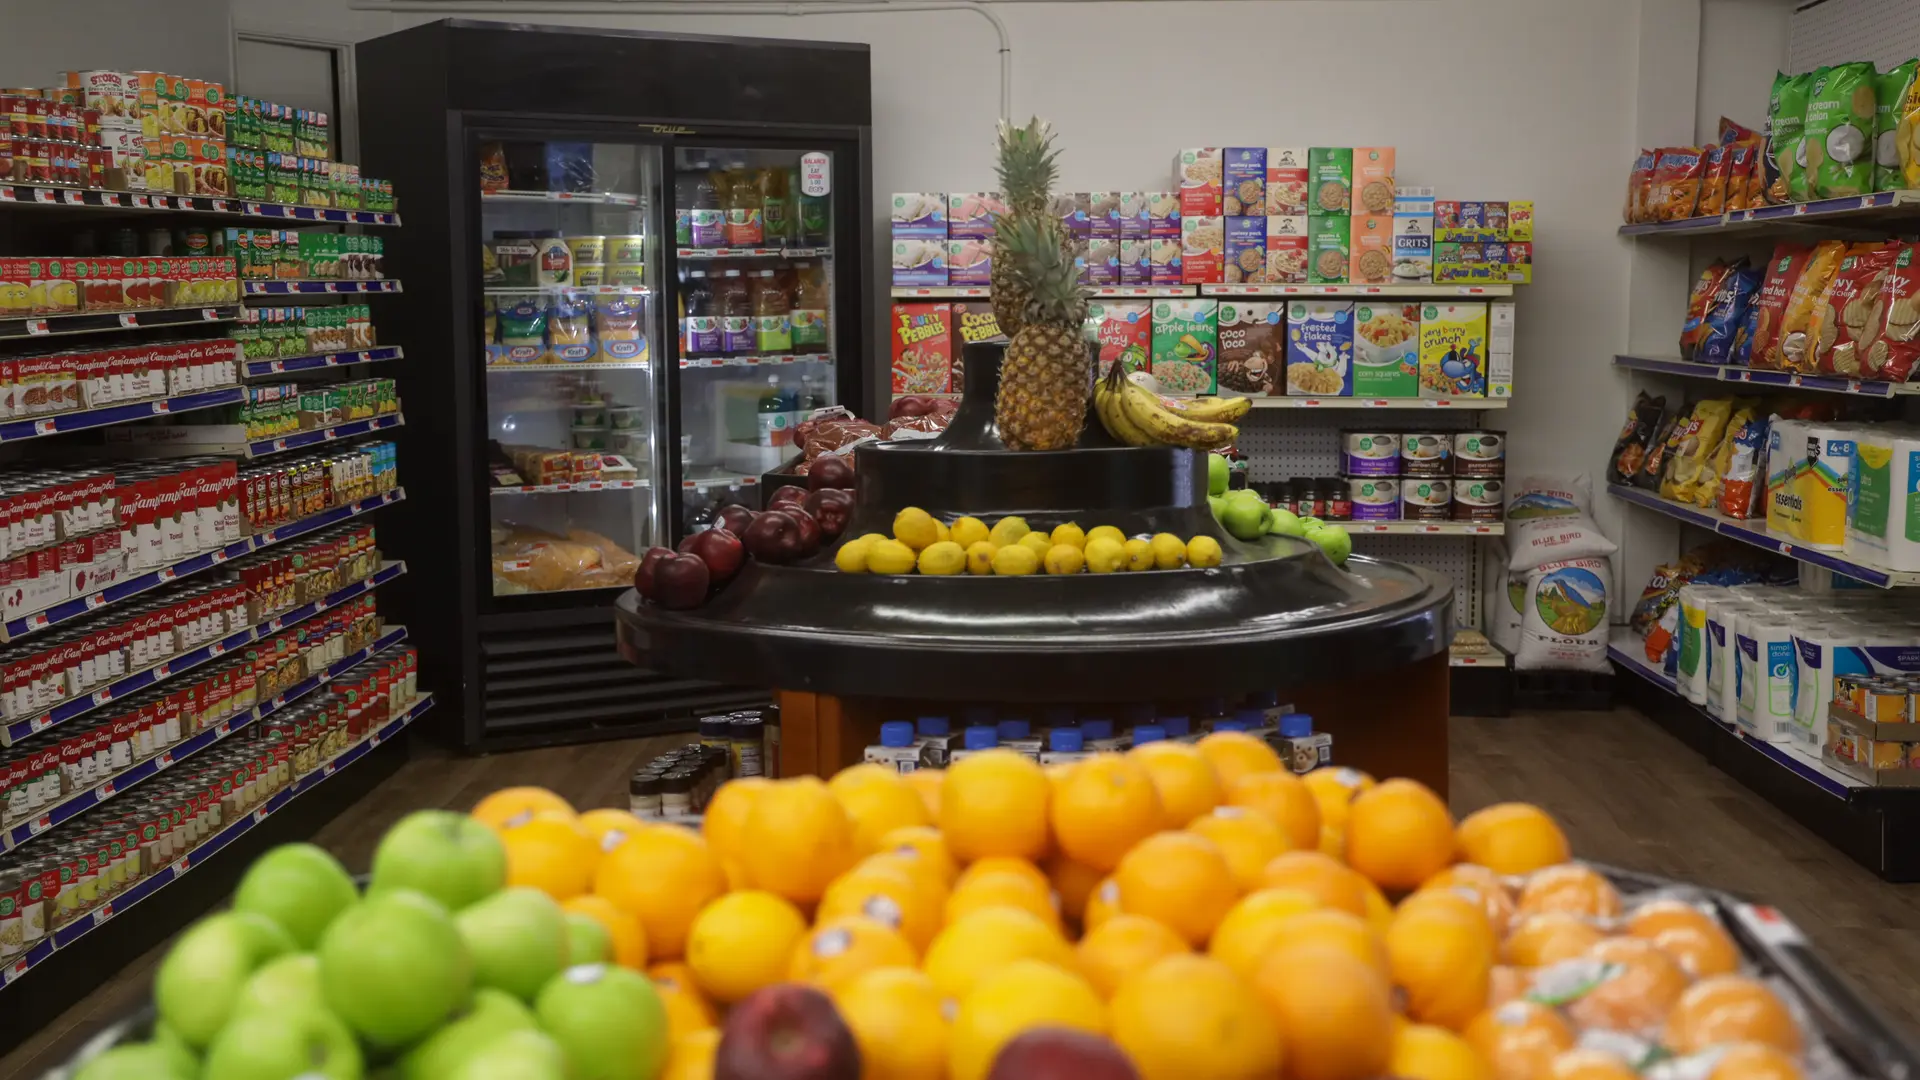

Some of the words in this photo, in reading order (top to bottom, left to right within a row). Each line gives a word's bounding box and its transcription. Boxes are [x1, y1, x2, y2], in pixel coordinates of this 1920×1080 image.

[1398, 238, 1429, 248] GRITS
[897, 321, 945, 345] PEBBLES
[1155, 322, 1184, 337] apple
[1301, 323, 1336, 334] frosted
[1220, 329, 1246, 340] coco
[1304, 332, 1332, 341] flakes
[1423, 330, 1441, 339] very
[1222, 339, 1246, 351] loco
[1424, 333, 1462, 350] crunch
[515, 347, 532, 356] Kraft
[568, 347, 584, 356] Kraft
[616, 343, 632, 352] Kraft
[1775, 492, 1802, 511] essentials
[1532, 534, 1556, 547] BLUE
[1560, 532, 1582, 542] BIRD
[1575, 559, 1602, 569] BIRD
[1538, 634, 1599, 646] FLOUR
